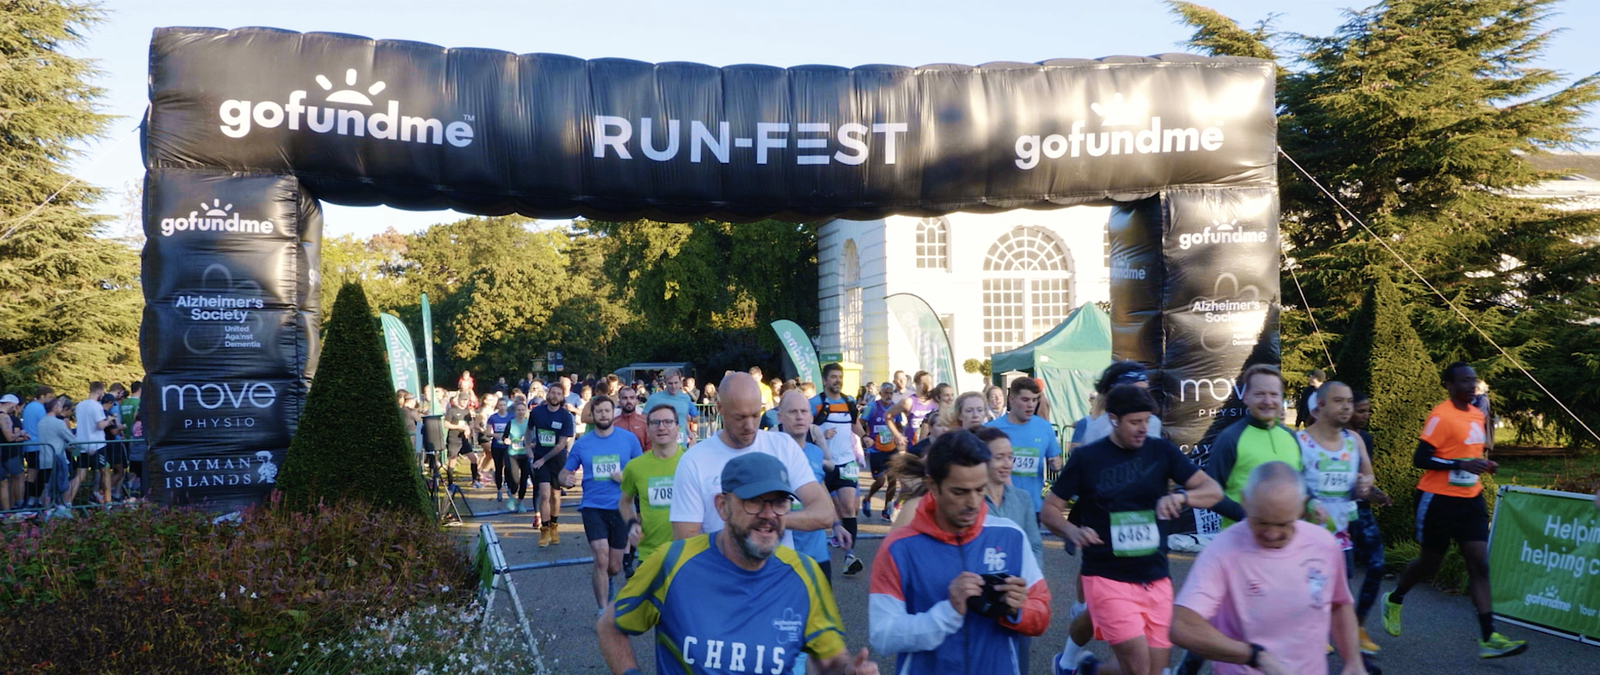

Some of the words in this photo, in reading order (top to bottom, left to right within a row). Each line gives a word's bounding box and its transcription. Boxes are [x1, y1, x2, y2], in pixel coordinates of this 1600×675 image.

[219, 90, 474, 147] gofundme
[593, 114, 908, 165] RUN-FEST
[1014, 117, 1224, 170] gofundme
[161, 210, 274, 237] gofundme
[1179, 226, 1267, 250] gofundme
[175, 295, 264, 308] Alzheimer's
[1192, 300, 1260, 312] Alzheimer's
[191, 308, 248, 323] Society
[224, 325, 250, 333] United
[224, 333, 254, 342] Against
[162, 382, 277, 411] move
[1180, 378, 1247, 402] mov
[185, 417, 255, 428] PHYSIO
[1179, 444, 1211, 455] CAY
[164, 457, 251, 473] CAYMAN
[596, 463, 617, 473] 6389
[165, 473, 252, 489] ISLANDS
[653, 487, 673, 500] 708
[1544, 514, 1600, 547] Helpin
[1520, 540, 1586, 578] helping
[1589, 558, 1600, 575] c
[1524, 591, 1571, 612] gofundme
[1578, 603, 1598, 617] Your
[683, 635, 786, 675] CHRIS
